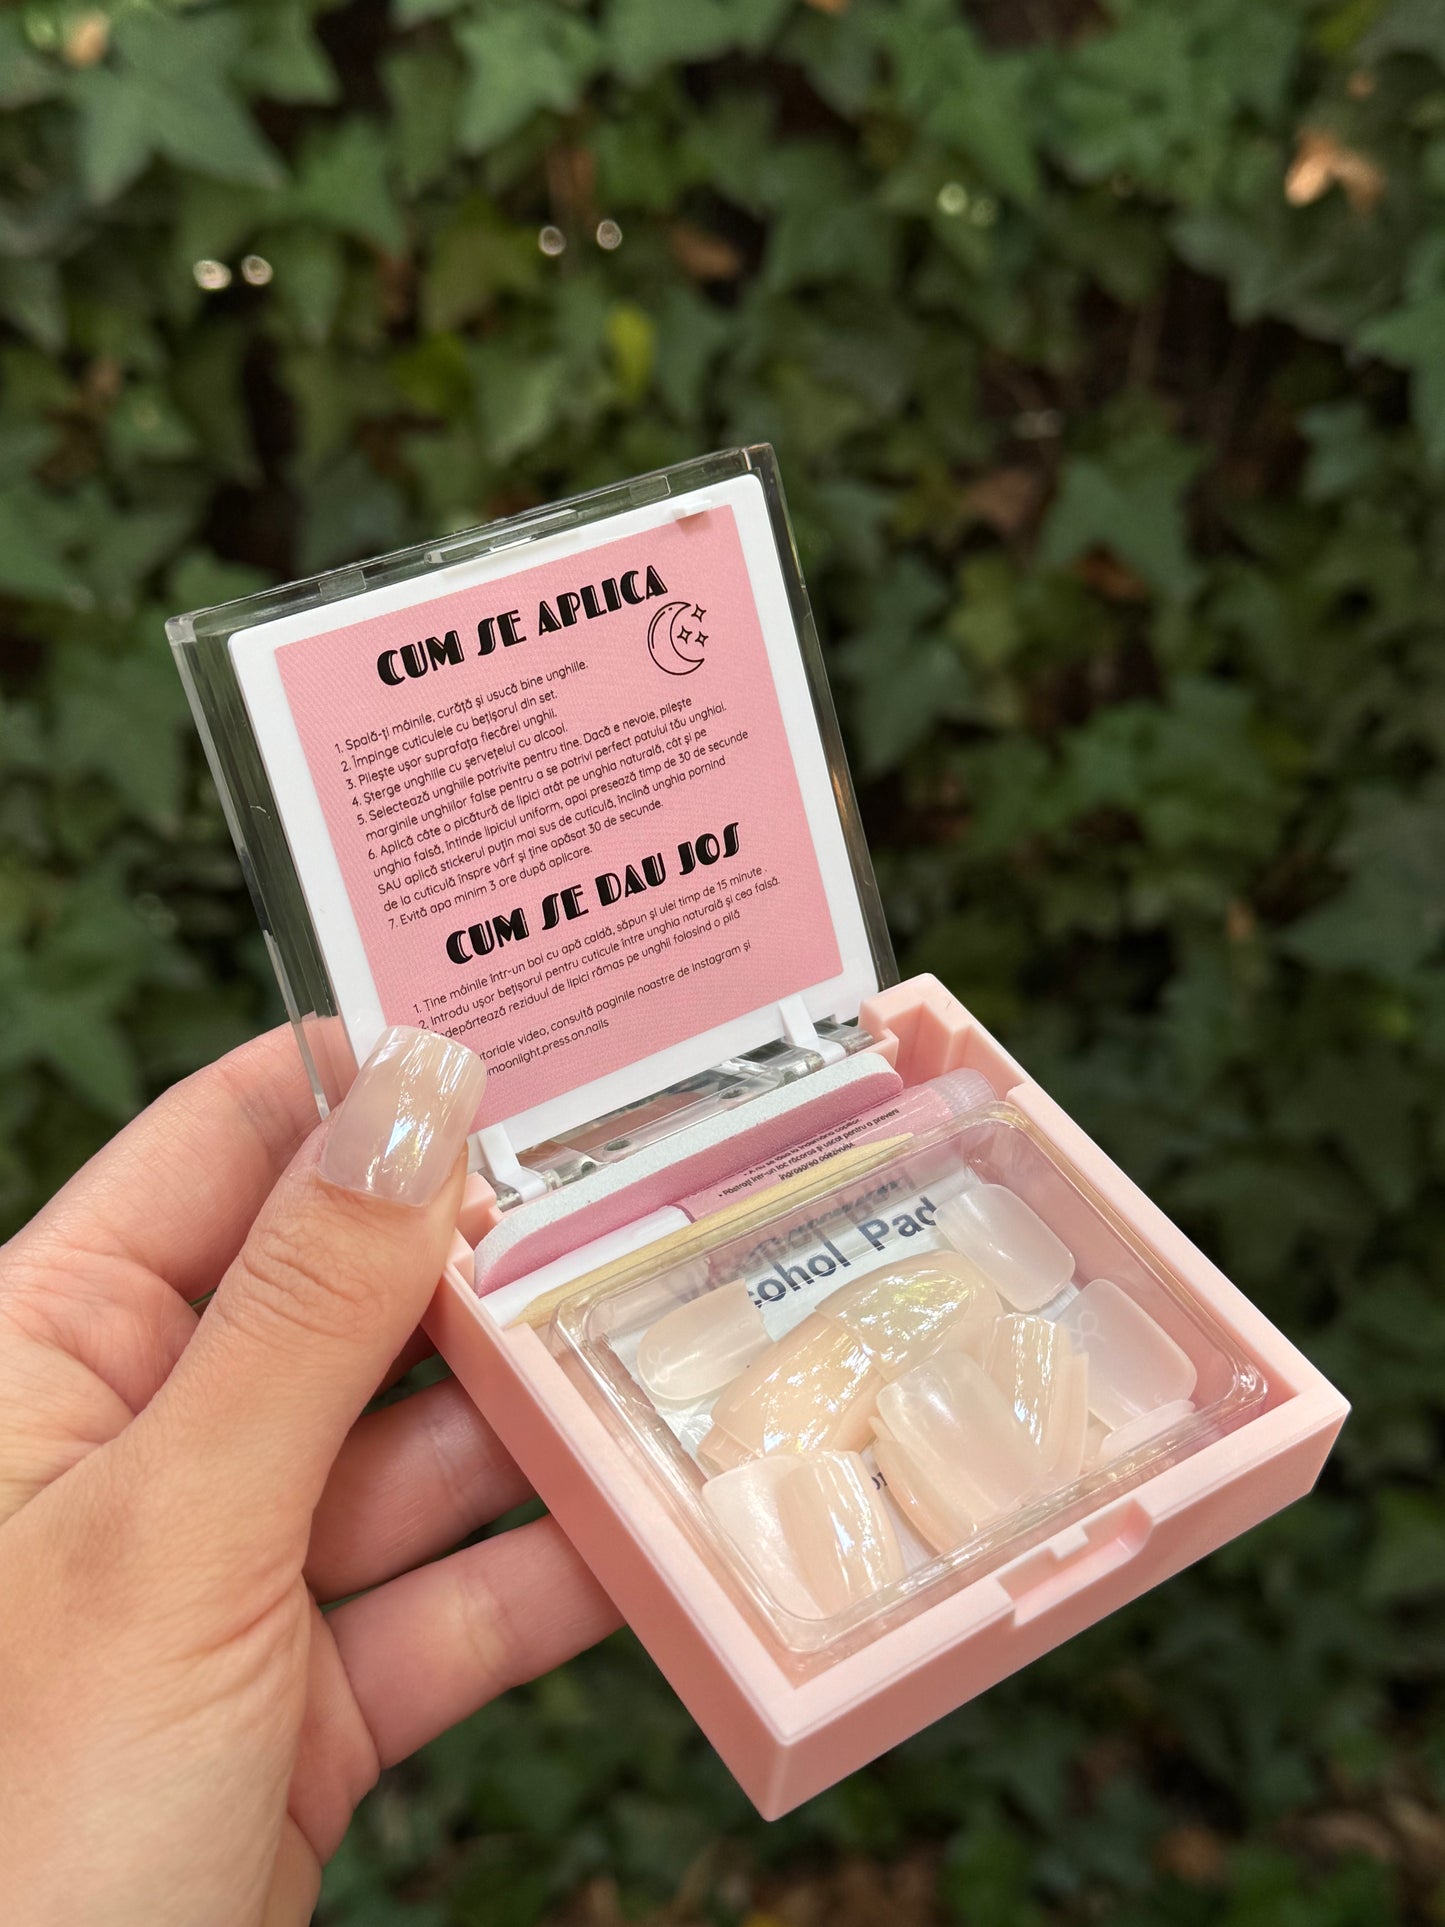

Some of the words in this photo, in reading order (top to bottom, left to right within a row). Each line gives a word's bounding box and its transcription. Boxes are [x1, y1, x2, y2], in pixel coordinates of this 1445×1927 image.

[376, 629, 465, 686] CUM
[477, 609, 527, 656] SE
[538, 564, 668, 636] APLICA
[350, 745, 399, 768] Împinge
[401, 725, 453, 751] cuticulele
[455, 720, 469, 732] cu
[519, 697, 537, 710] din
[538, 689, 557, 703] set.
[391, 712, 435, 735] mâinile,
[485, 682, 518, 702] usucă
[519, 675, 543, 690] bine
[545, 660, 588, 681] unghiile.
[479, 719, 521, 742] fiecărei
[522, 707, 557, 728] unghii.
[365, 815, 418, 842] marginile
[420, 797, 467, 822] unghiilor
[469, 787, 496, 803] false
[498, 774, 534, 795] pentru
[560, 750, 593, 773] potrivi
[594, 736, 632, 760] perfect
[633, 722, 668, 746] patului
[668, 717, 686, 730] tău
[688, 700, 726, 723] unghial.
[368, 790, 430, 821] Selectează
[431, 775, 474, 798] unghiile
[476, 759, 521, 785] potrivite
[522, 746, 557, 768] pentru
[559, 738, 582, 752] tine.
[582, 725, 611, 743] Dacă
[621, 710, 658, 729] nevoie,
[372, 856, 411, 877] unghia
[413, 843, 444, 862] falsă,
[444, 829, 482, 851] întinde
[483, 814, 517, 837] lipiciul
[518, 801, 563, 823] uniform,
[564, 788, 588, 806] apoi
[589, 770, 637, 799] presează
[638, 763, 662, 778] timp
[677, 750, 691, 763] 30
[692, 746, 706, 758] de
[707, 729, 748, 752] secunde
[380, 834, 414, 856] Aplică
[416, 826, 441, 842] câte
[453, 803, 499, 831] picătură
[500, 799, 515, 811] de
[515, 788, 540, 806] lipici
[542, 780, 564, 796] atât
[565, 775, 580, 789] pe
[581, 761, 617, 781] unghia
[618, 743, 664, 767] naturală,
[665, 736, 682, 750] cât
[693, 728, 707, 742] pe
[403, 766, 446, 789] unghiile
[448, 761, 462, 773] cu
[517, 737, 531, 748] cu
[533, 721, 568, 743] alcool.
[377, 877, 401, 895] SAU
[403, 863, 438, 885] aplică
[439, 845, 485, 872] stickerul
[515, 826, 537, 843] mai
[538, 821, 556, 835] sus
[557, 815, 572, 827] de
[574, 797, 616, 821] cuticulă,
[616, 783, 650, 804] înclină
[651, 772, 686, 791] unghia
[687, 754, 726, 780] pornind
[383, 899, 398, 912] de
[413, 876, 456, 900] cuticulă
[456, 864, 491, 884] înspre
[492, 852, 515, 869] vârf
[550, 827, 587, 848] apăsat
[587, 820, 601, 834] 30
[603, 816, 617, 828] de
[618, 799, 663, 822] secunde.
[399, 906, 427, 925] Evită
[429, 898, 452, 914] apa
[453, 885, 487, 904] minim
[498, 874, 517, 887] ore
[518, 860, 546, 879] după
[548, 845, 592, 868] aplicare.
[445, 907, 529, 964] CUM
[541, 883, 589, 930] SE
[594, 852, 666, 906] DAU
[677, 821, 739, 875] JOS
[448, 977, 488, 999] mâinile
[488, 962, 526, 983] într-un
[526, 952, 544, 968] bol
[545, 949, 559, 960] cu
[560, 938, 582, 954] apă
[583, 925, 615, 945] caldă,
[616, 913, 647, 932] săpun
[658, 899, 676, 914] ulei
[677, 891, 701, 906] timp
[702, 885, 715, 896] de
[716, 878, 727, 891] 15
[729, 866, 762, 886] minute
[429, 1003, 469, 1026] Introdu
[544, 959, 579, 981] pentru
[580, 942, 620, 964] cuticule
[620, 932, 645, 948] între
[646, 917, 680, 937] unghia
[682, 897, 723, 922] naturală
[734, 888, 753, 901] cea
[754, 875, 780, 893] falsă.
[508, 986, 549, 1012] reziduul
[551, 982, 565, 994] de
[566, 970, 590, 988] lipici
[591, 958, 624, 978] rămas
[625, 952, 639, 966] pe
[641, 936, 671, 957] unghii
[672, 919, 712, 944] folosind
[722, 908, 740, 926] pilă
[516, 1027, 549, 1045] video,
[550, 1005, 594, 1031] consultă
[595, 989, 635, 1014] paginile
[636, 973, 675, 995] noastre
[676, 966, 690, 978] de
[691, 945, 741, 972] Instagram
